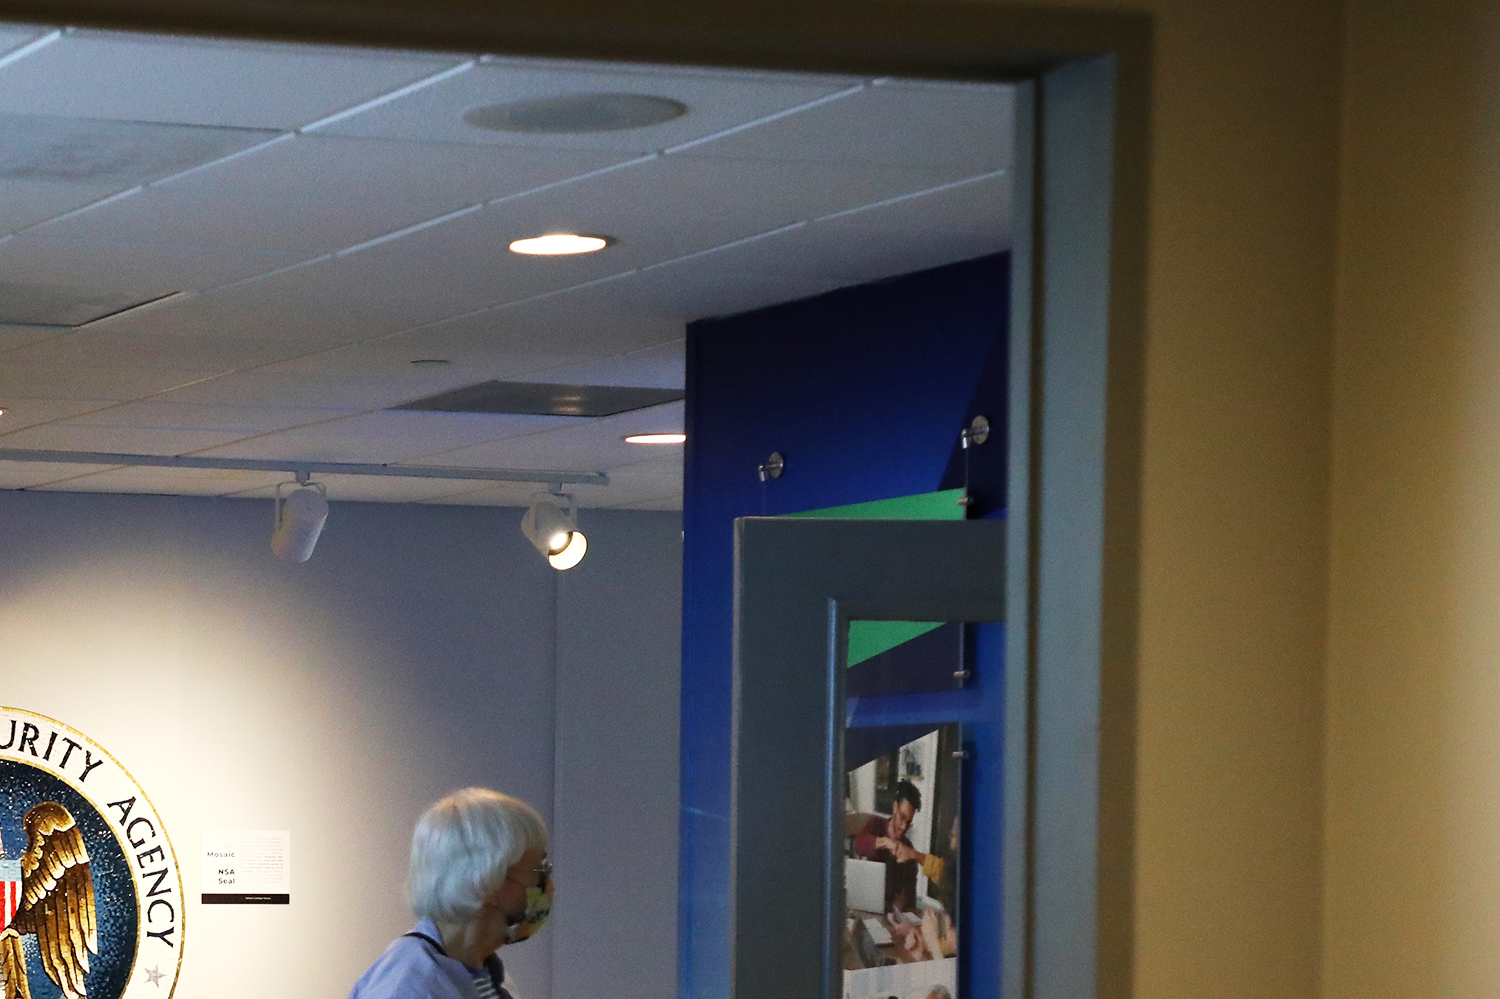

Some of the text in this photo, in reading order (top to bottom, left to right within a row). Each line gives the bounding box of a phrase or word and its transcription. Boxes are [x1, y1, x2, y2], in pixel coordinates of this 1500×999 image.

[207, 850, 235, 858] Mosaic
[106, 796, 175, 948] AGENCY
[218, 877, 235, 885] Seal
